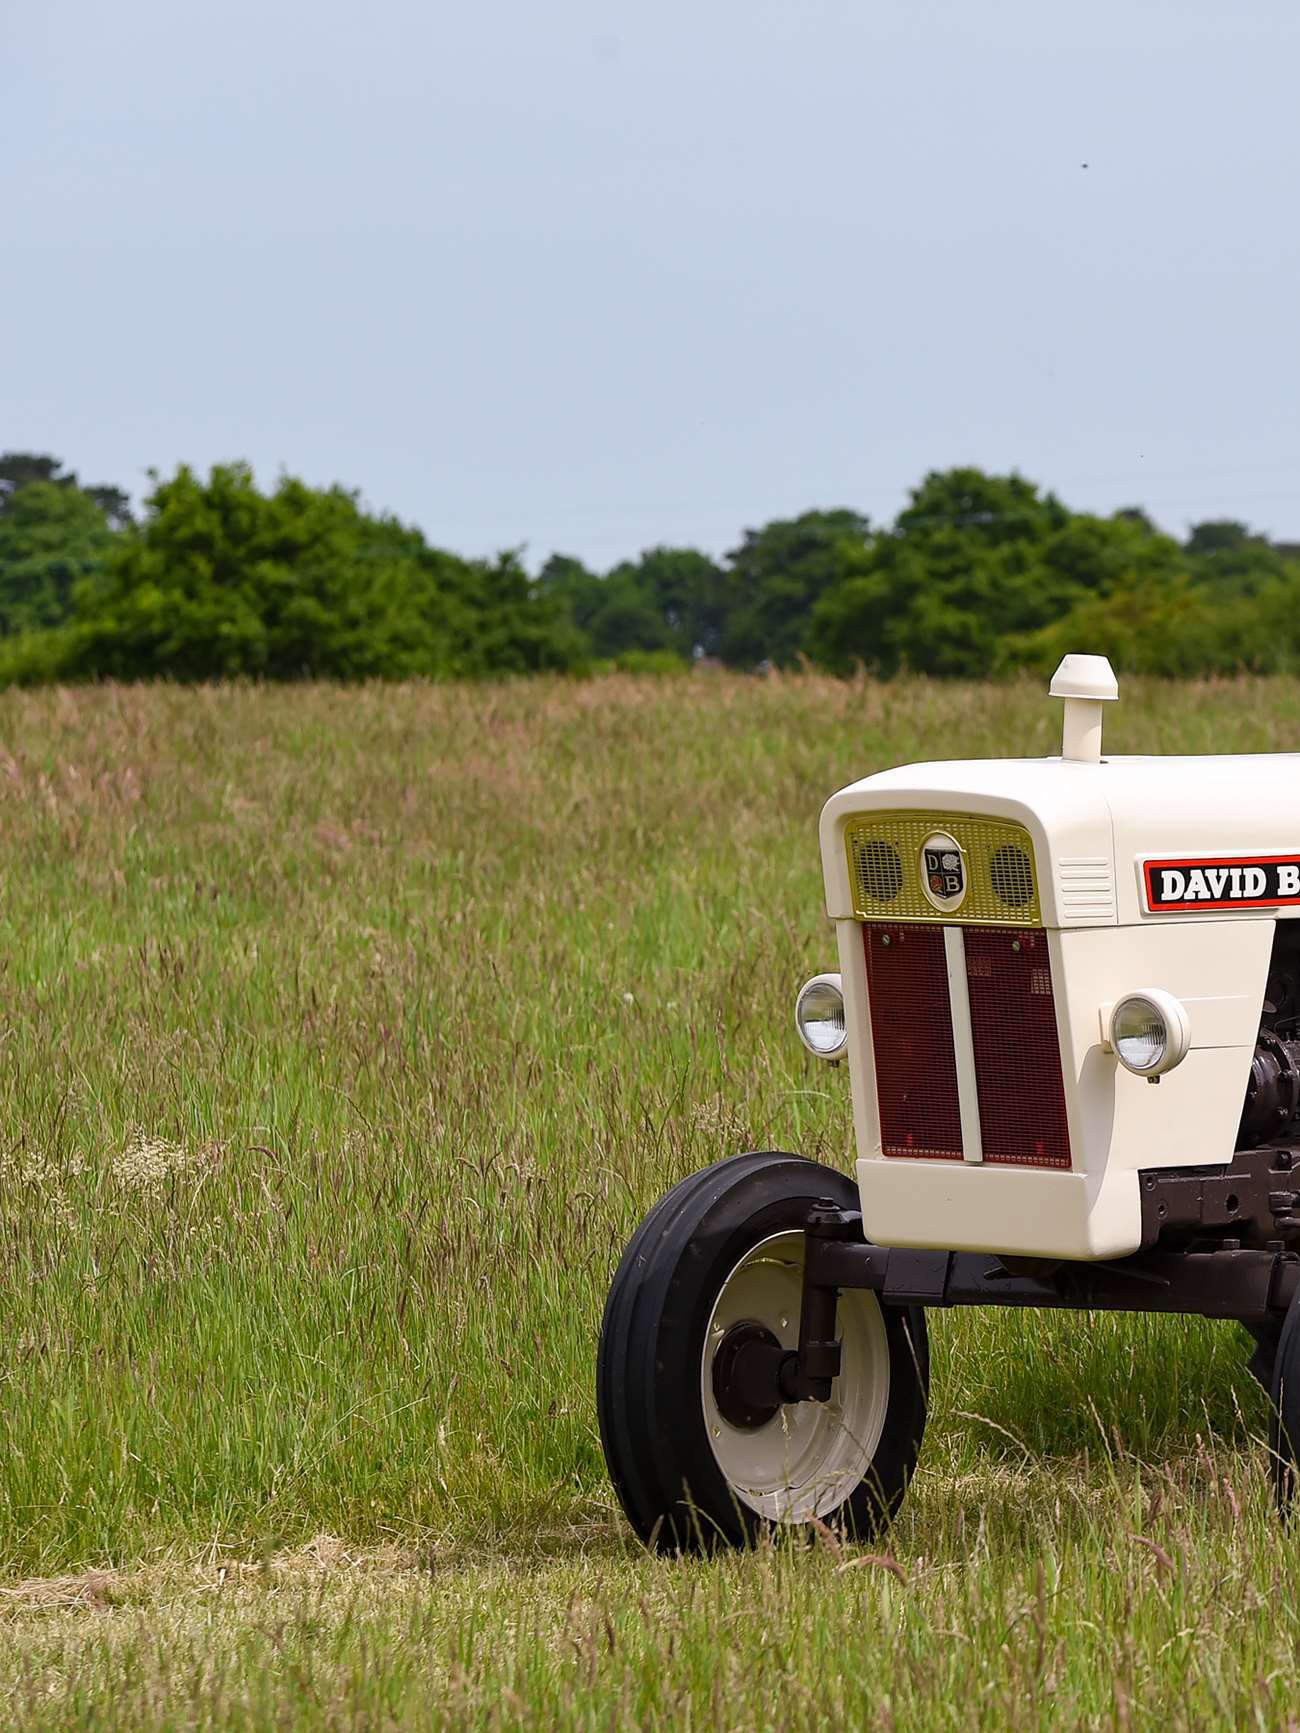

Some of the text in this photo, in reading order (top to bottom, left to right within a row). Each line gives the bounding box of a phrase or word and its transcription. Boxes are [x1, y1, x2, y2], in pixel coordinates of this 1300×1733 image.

[927, 854, 938, 870] D
[945, 875, 960, 892] B
[1161, 867, 1267, 901] DAVID
